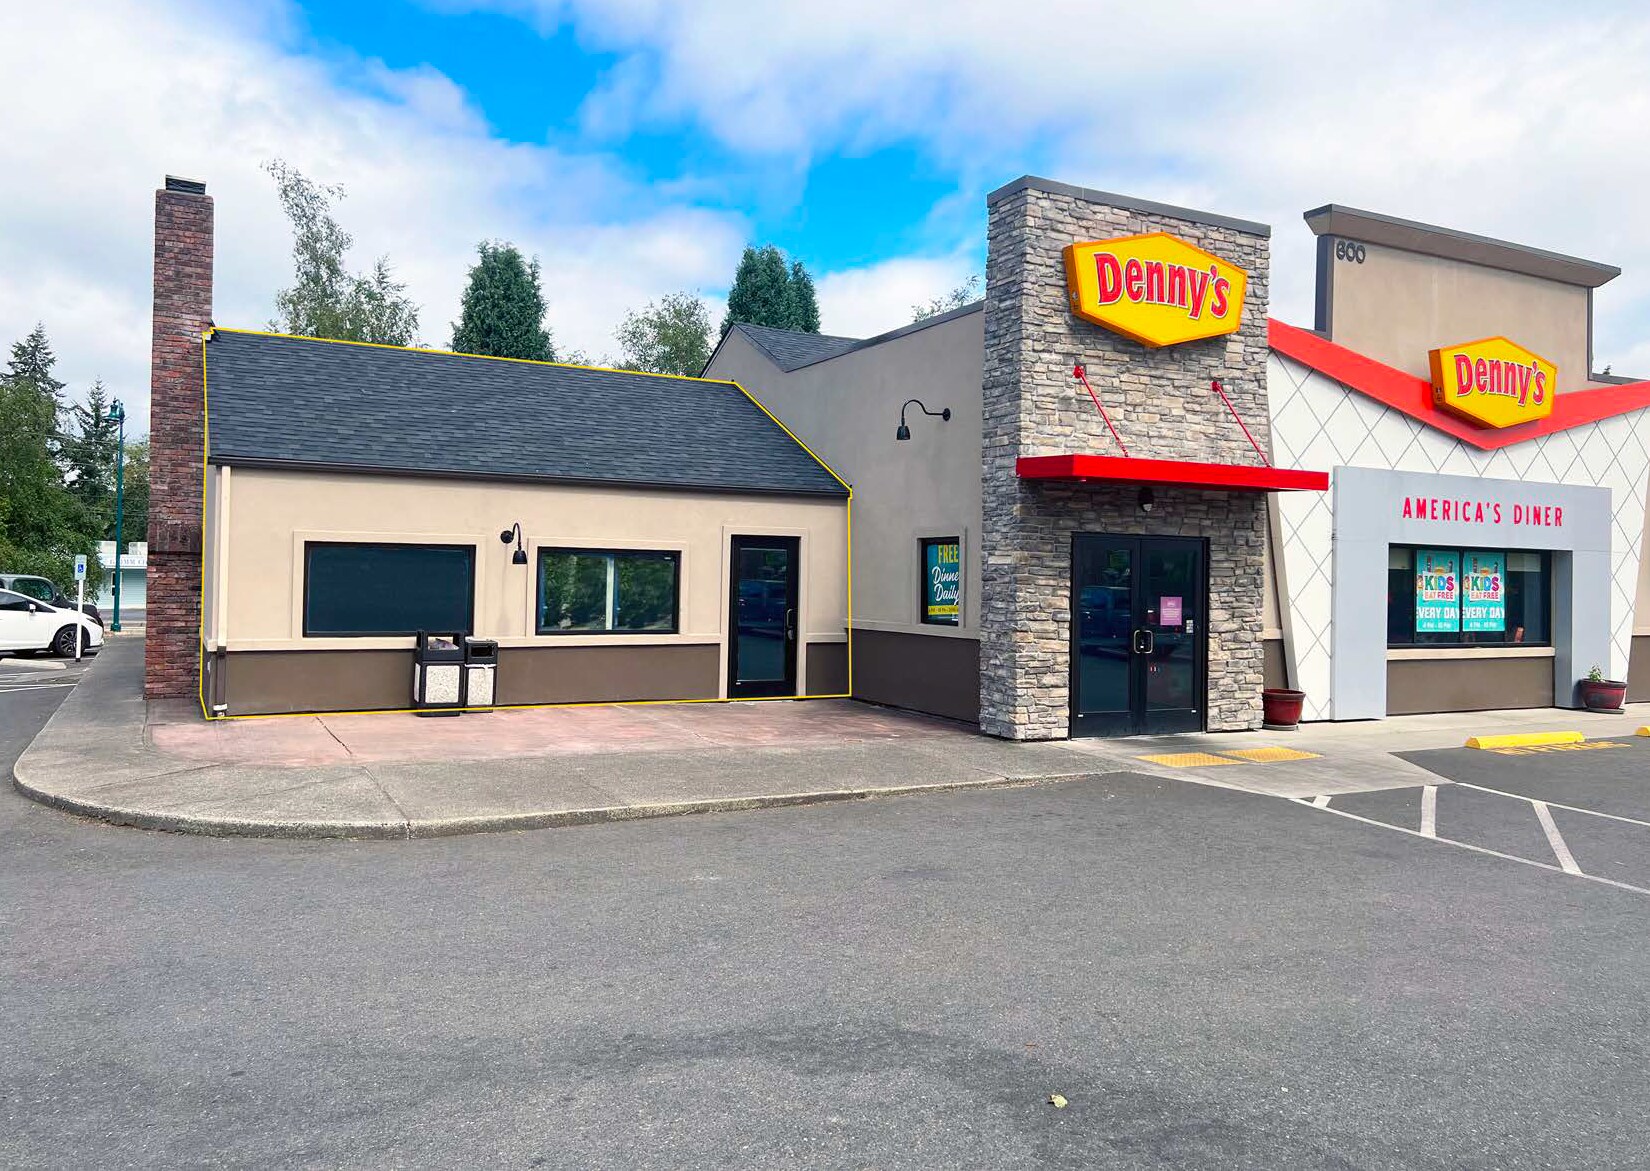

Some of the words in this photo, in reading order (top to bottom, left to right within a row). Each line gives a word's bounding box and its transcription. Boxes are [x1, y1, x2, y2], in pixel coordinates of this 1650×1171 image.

[1093, 252, 1231, 320] Denny's
[1453, 353, 1547, 407] Denny's
[1402, 497, 1501, 524] AMERICA'S
[1513, 504, 1563, 527] DINER
[938, 544, 959, 563] FREE
[932, 566, 959, 584] Dinne
[1424, 575, 1454, 591] KIDS
[1471, 576, 1500, 591] KIDS
[934, 584, 960, 605] Daily
